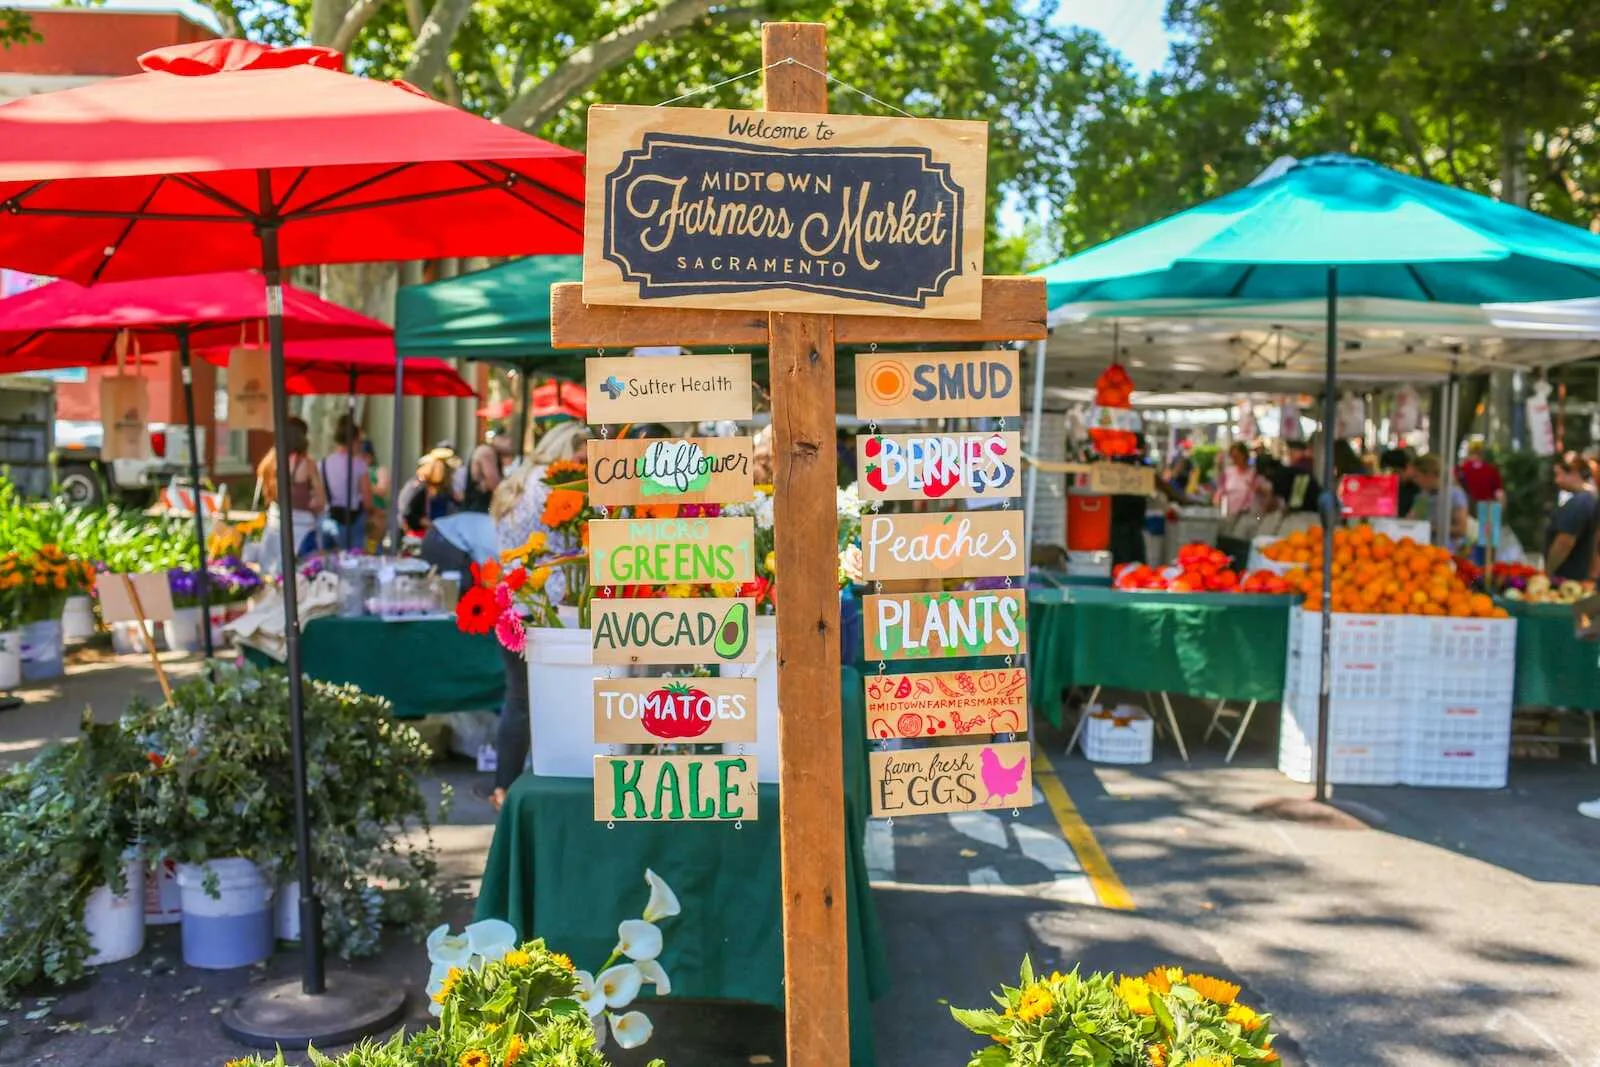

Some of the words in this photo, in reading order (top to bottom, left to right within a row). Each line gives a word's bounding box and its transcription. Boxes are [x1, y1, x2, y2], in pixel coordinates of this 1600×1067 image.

[728, 113, 809, 140] Welcome
[816, 120, 836, 141] to
[701, 171, 832, 194] MIDTOWN
[625, 173, 794, 253] Farmers
[799, 181, 948, 271] Market
[676, 255, 847, 277] SACRAMENTO
[628, 378, 676, 398] Sutter
[681, 375, 733, 393] Health
[911, 361, 1014, 402] SMUD
[594, 441, 749, 493] cauliflower
[880, 435, 1008, 490] BERRIES
[629, 520, 710, 542] MICRO
[868, 517, 1018, 574] Peaches
[609, 543, 735, 582] GREENS
[877, 595, 1020, 651] PLANTS
[599, 691, 748, 722] TOMATOES
[869, 696, 1023, 712] #MIDTOWNFARMERSMARKET
[884, 756, 924, 785] farm
[928, 752, 976, 783] fresh
[609, 757, 748, 820] KALE
[880, 773, 977, 811] EGGS
